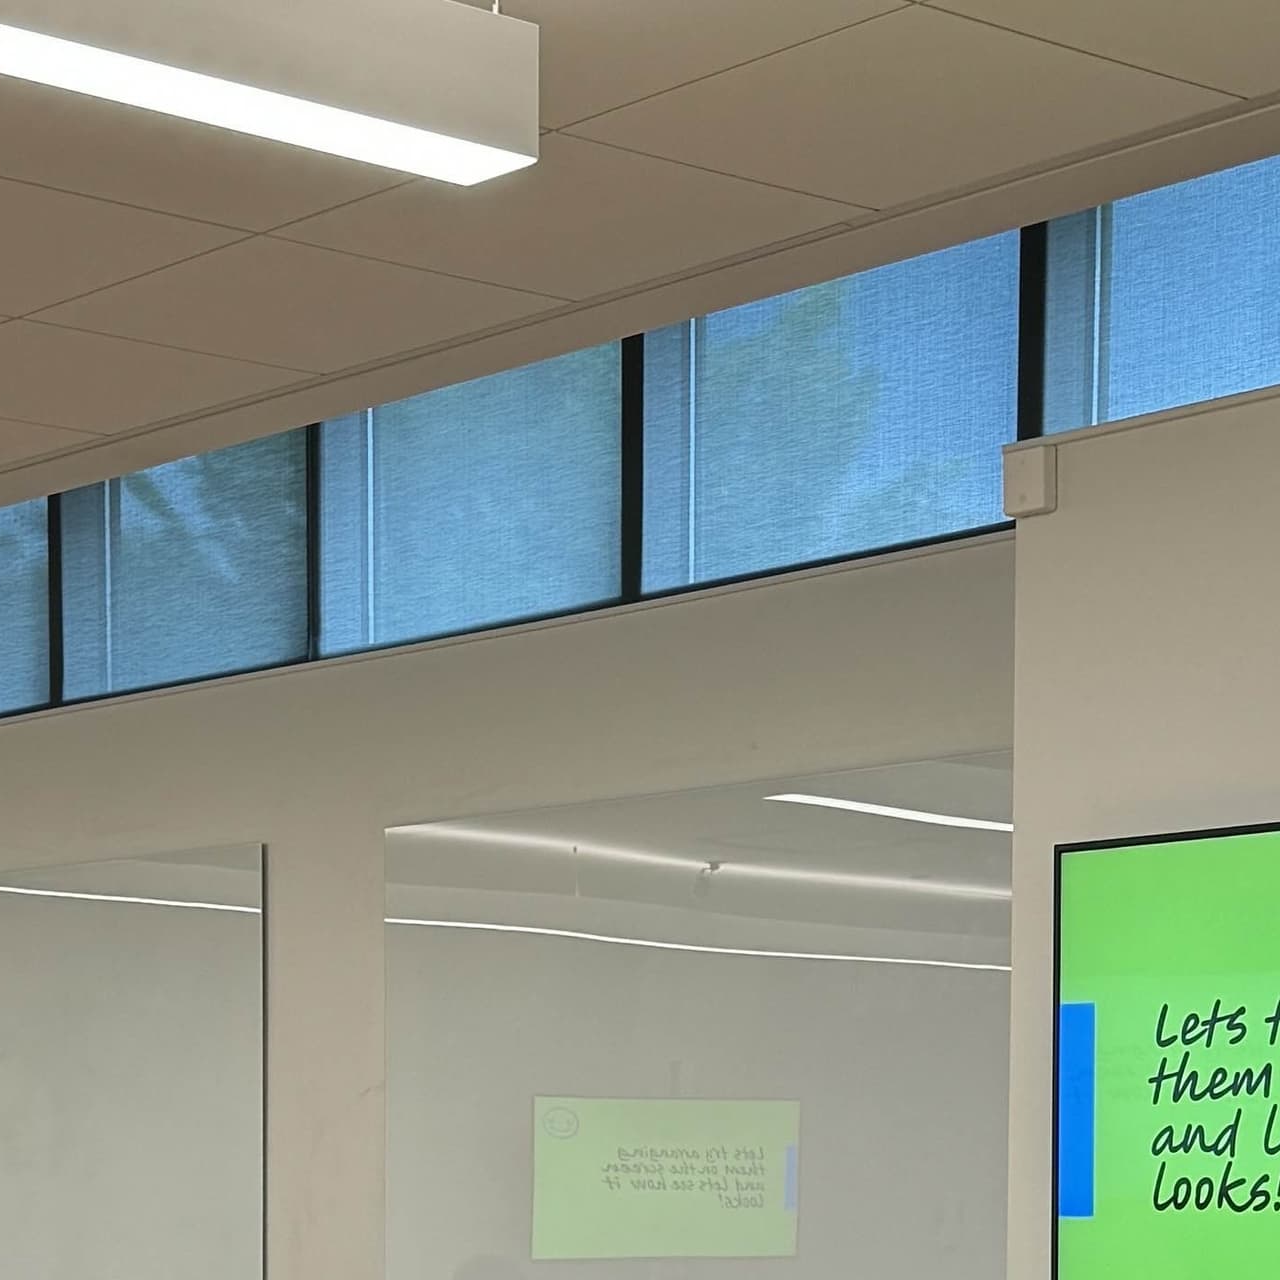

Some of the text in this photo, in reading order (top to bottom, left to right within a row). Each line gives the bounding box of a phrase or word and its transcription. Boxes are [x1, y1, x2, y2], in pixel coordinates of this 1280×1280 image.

[1155, 998, 1248, 1049] Lets
[1147, 1050, 1274, 1106] them
[1150, 1107, 1243, 1159] and
